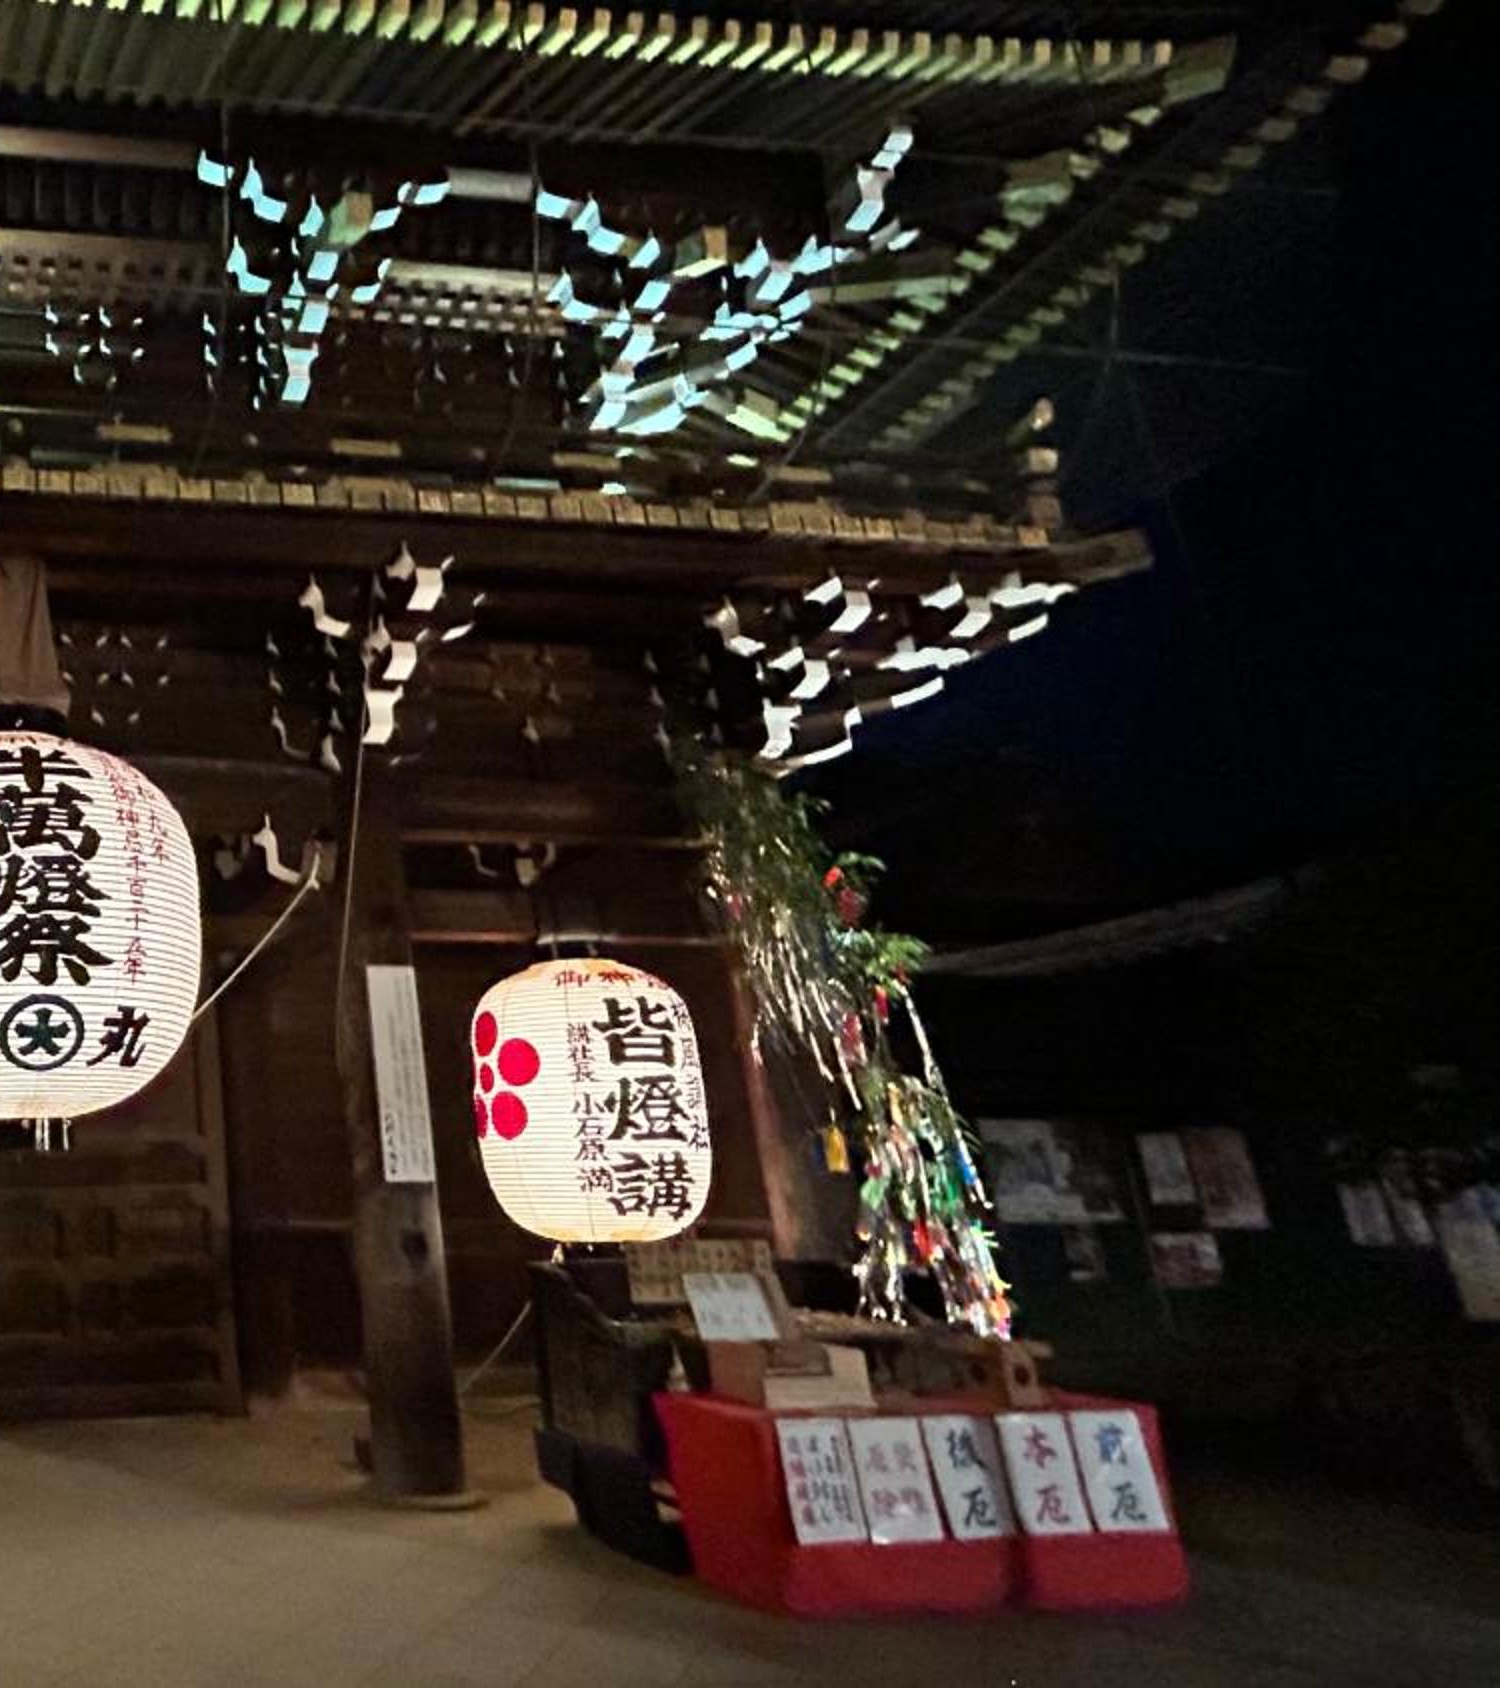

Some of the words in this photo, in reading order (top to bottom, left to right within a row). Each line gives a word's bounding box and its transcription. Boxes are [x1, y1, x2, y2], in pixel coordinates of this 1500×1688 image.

[592, 996, 696, 1221] 皆燈講
[947, 1428, 997, 1529] 後厄
[1023, 1426, 1070, 1525] 本厄
[1096, 1423, 1147, 1522] 前厄
